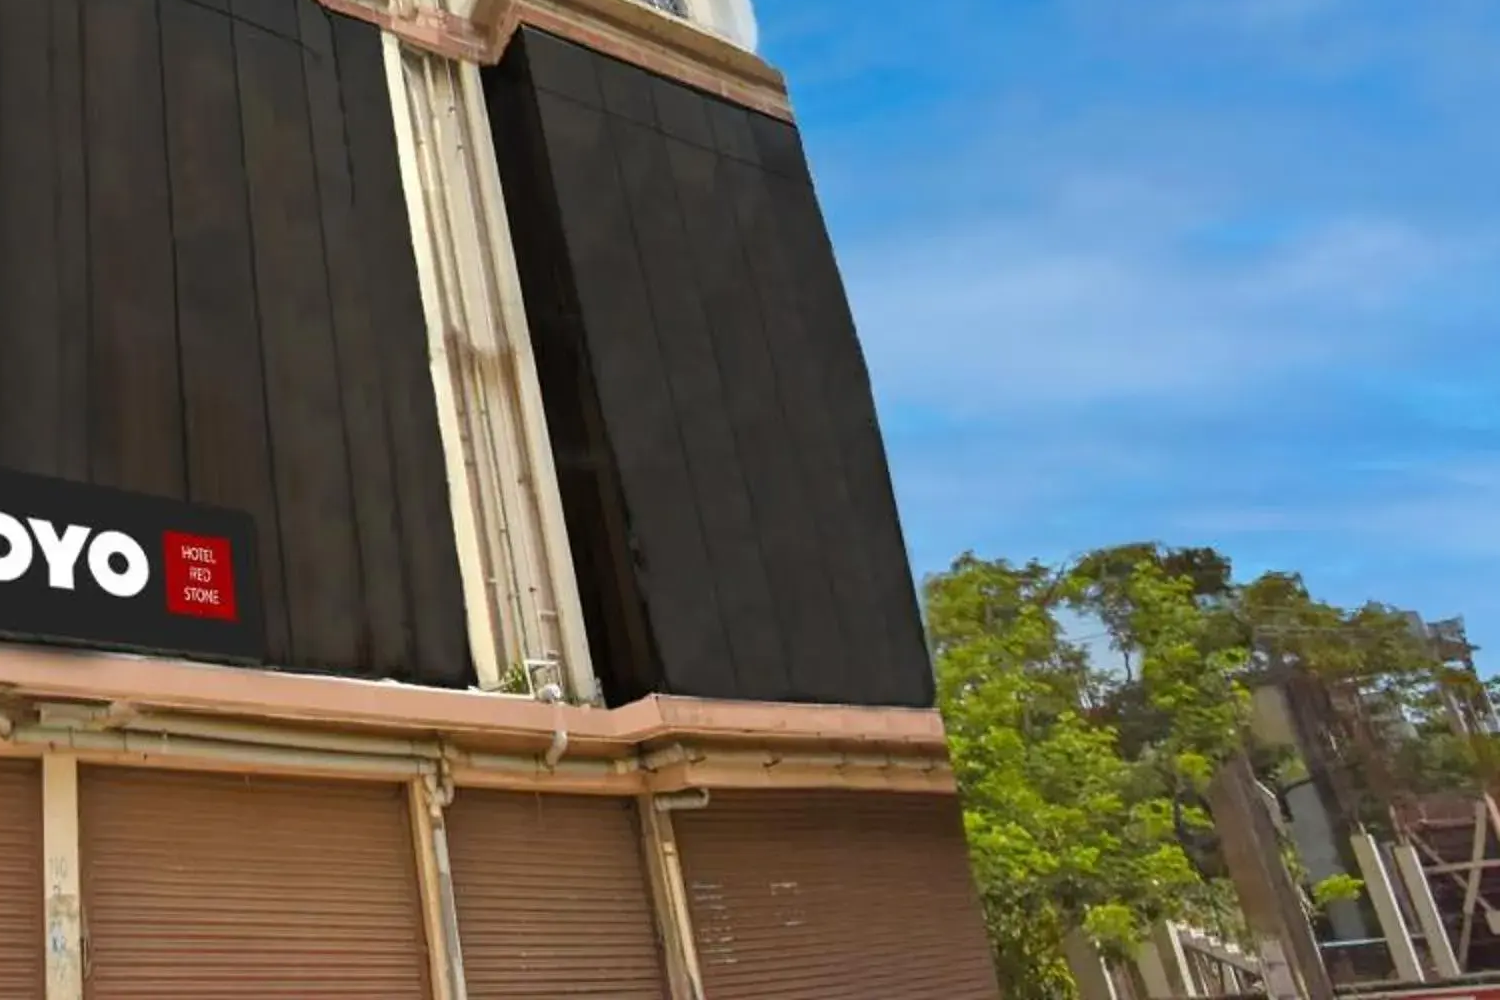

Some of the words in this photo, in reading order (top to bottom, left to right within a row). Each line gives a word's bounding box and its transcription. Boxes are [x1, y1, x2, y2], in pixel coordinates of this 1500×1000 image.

[181, 545, 216, 564] HOTEL
[189, 566, 211, 582] RED
[183, 587, 220, 604] STONE
